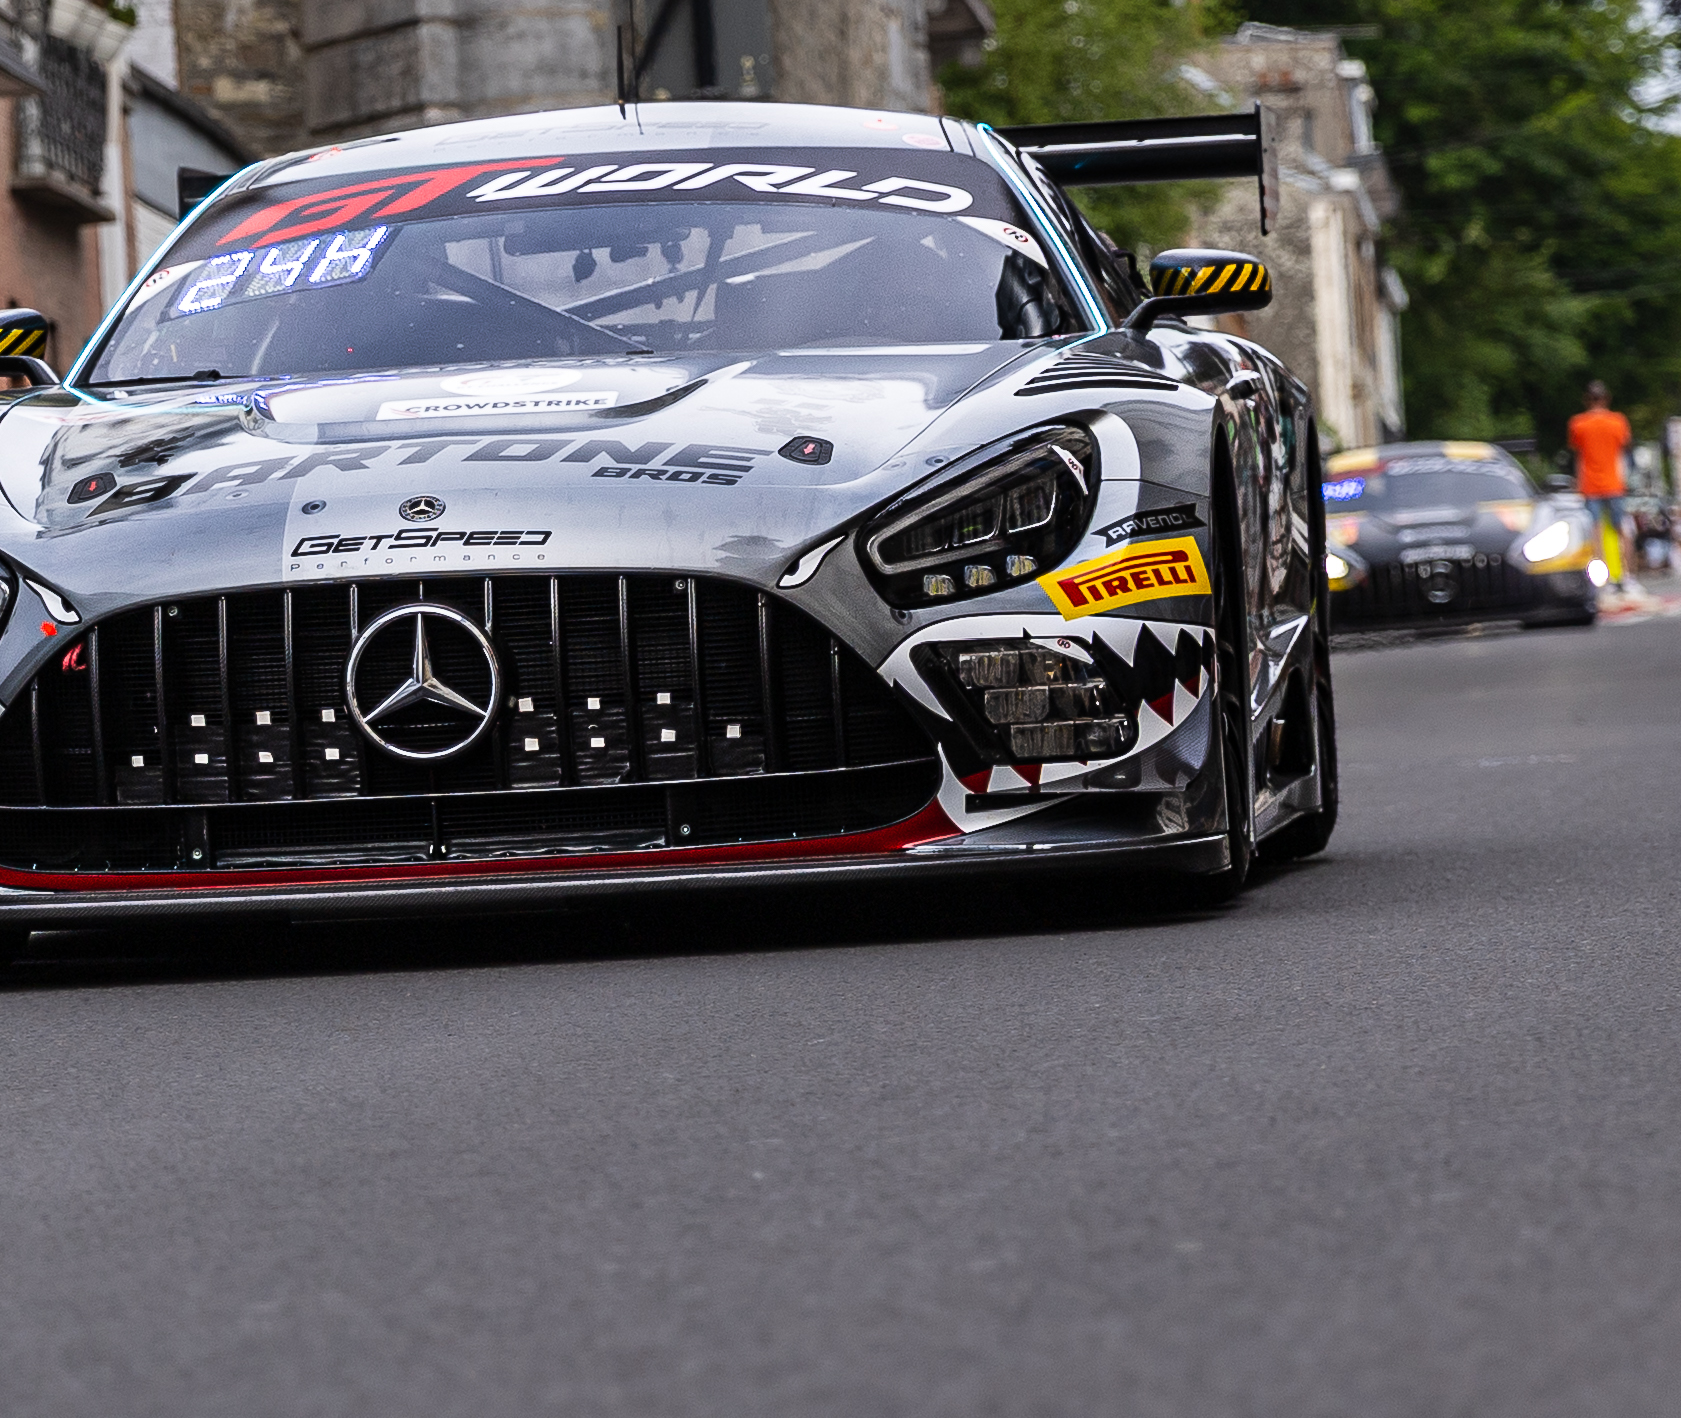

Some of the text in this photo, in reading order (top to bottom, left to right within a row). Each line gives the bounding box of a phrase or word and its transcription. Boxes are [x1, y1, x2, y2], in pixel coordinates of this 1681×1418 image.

[215, 157, 974, 249] GT WORLD
[177, 224, 389, 312] 24H
[406, 397, 608, 414] CROWDSTRIKE
[86, 439, 774, 519] BARTONE
[590, 466, 744, 486] BROS
[1107, 512, 1195, 540] RAVENOL
[290, 551, 546, 573] Performance
[1057, 549, 1198, 608] PIRELLI
